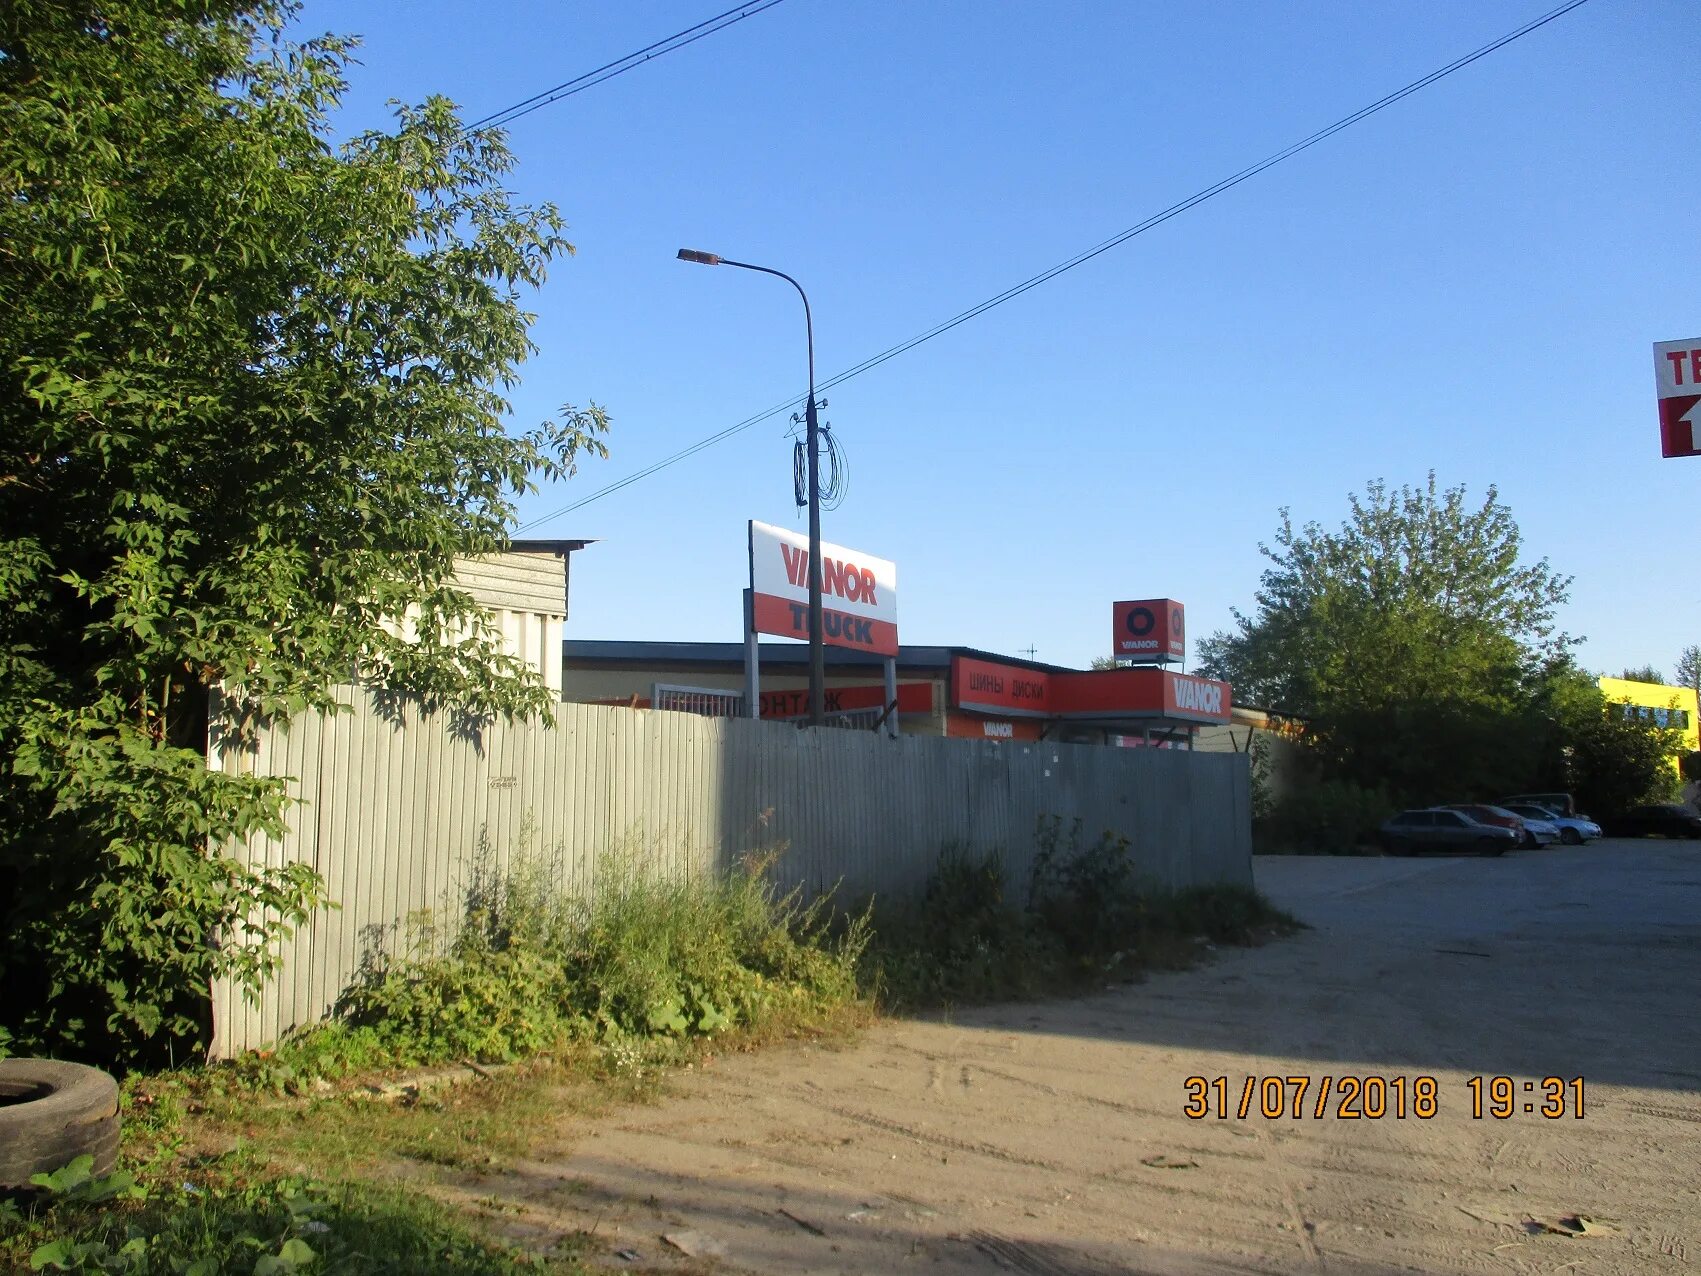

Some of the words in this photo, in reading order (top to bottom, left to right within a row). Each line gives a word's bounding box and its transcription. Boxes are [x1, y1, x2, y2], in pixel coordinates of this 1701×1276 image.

[780, 543, 877, 606] VINOR
[789, 603, 873, 644] TUCK
[1122, 640, 1159, 649] VIANOR
[969, 672, 1004, 694] ШИНЫ
[1012, 679, 1043, 699] ДИСКИ
[1174, 678, 1222, 713] VIANOR
